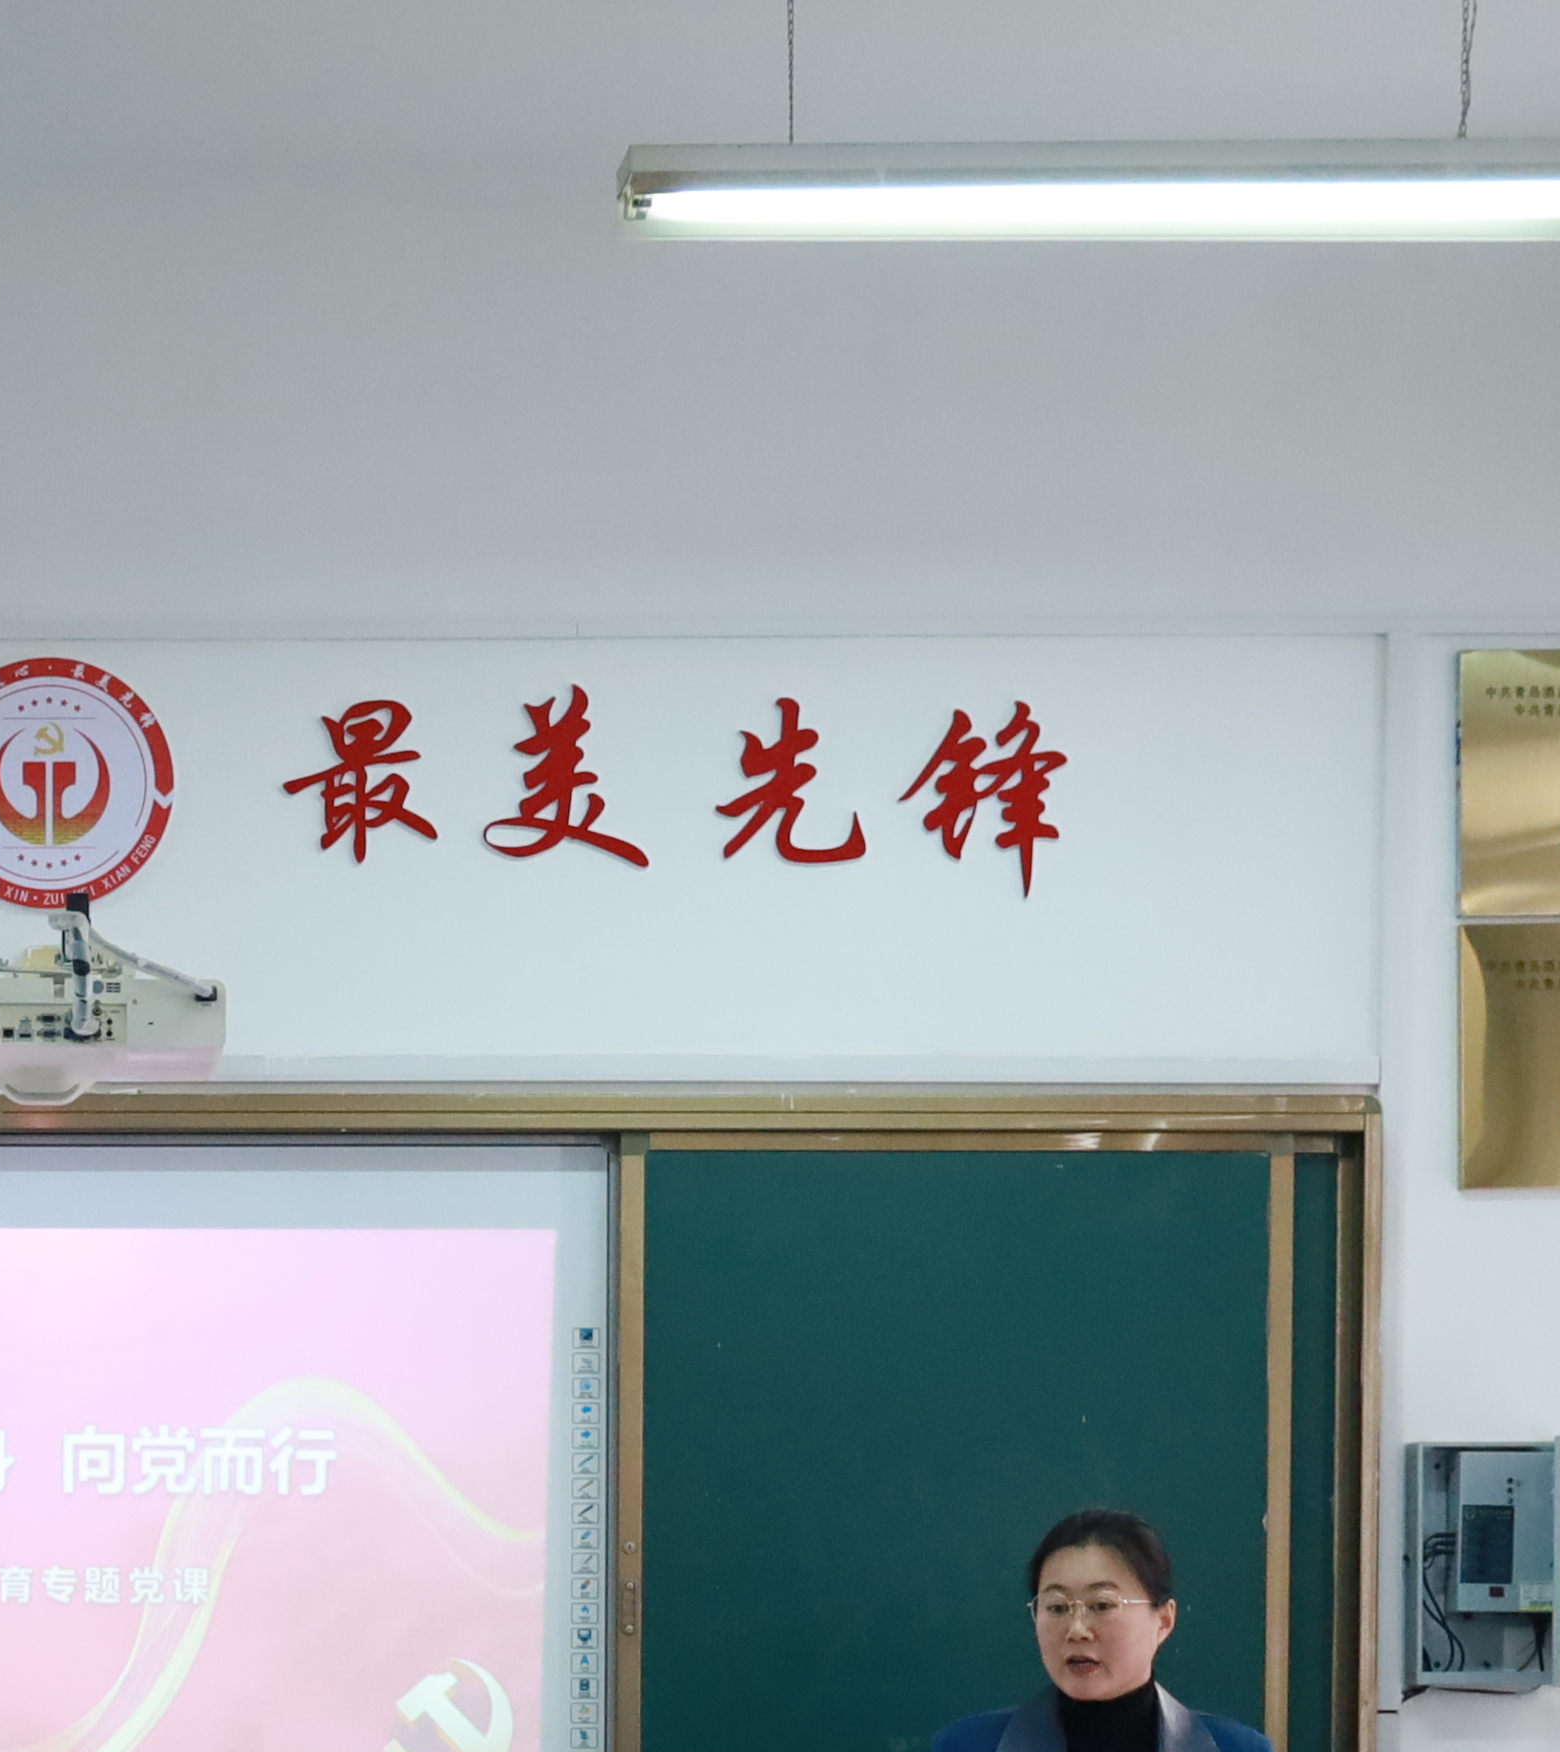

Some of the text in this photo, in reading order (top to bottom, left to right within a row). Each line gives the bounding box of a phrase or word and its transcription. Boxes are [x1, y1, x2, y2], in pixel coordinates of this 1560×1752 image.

[70, 664, 157, 729] 最美先锋
[282, 684, 1069, 899] 最美先锋
[4, 886, 30, 902] XIN
[43, 893, 66, 905] ZUI
[101, 865, 132, 890] XIAN
[129, 834, 157, 865] FENG
[61, 1422, 337, 1496] 向党而行
